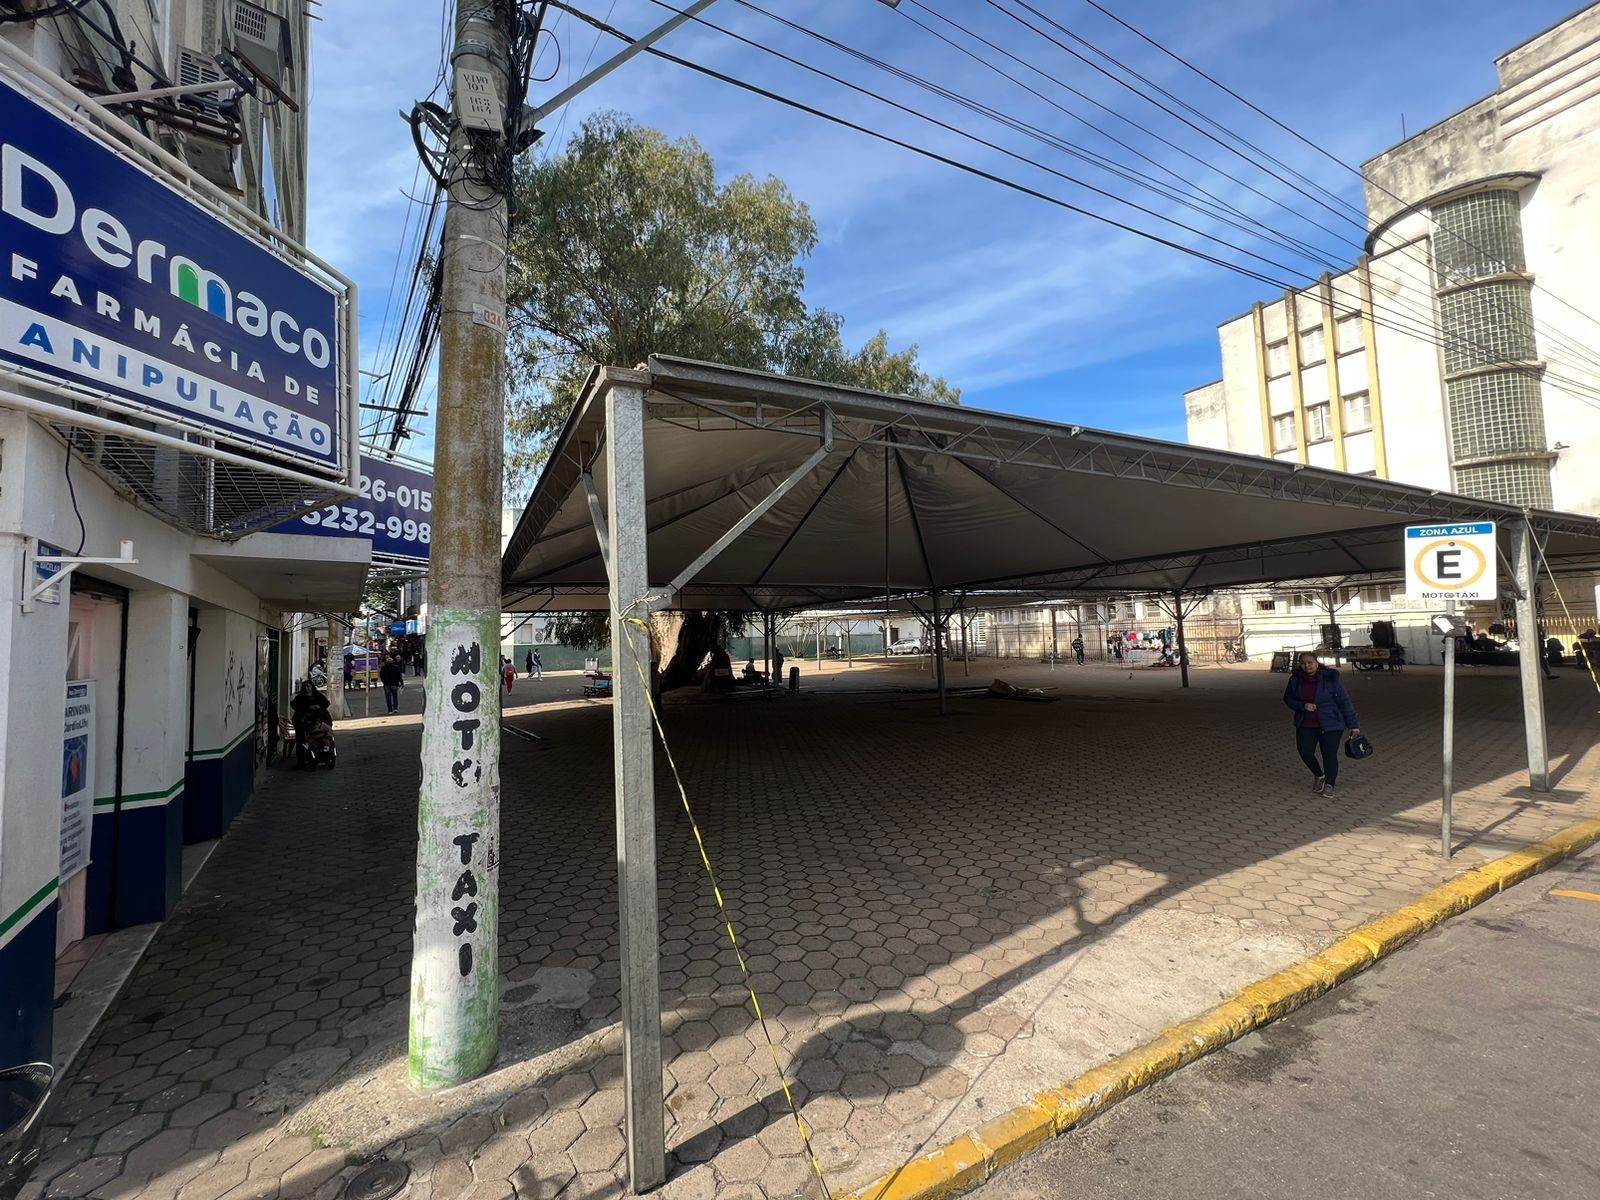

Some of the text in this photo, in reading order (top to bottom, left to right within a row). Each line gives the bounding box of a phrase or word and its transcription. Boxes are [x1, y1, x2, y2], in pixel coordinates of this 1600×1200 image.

[2, 143, 331, 370] Dermaco
[11, 252, 319, 405] FARMÁCIA DE
[1420, 525, 1479, 536] ZONA AZUL
[1436, 550, 1462, 579] E
[451, 832, 480, 977] TAXI
